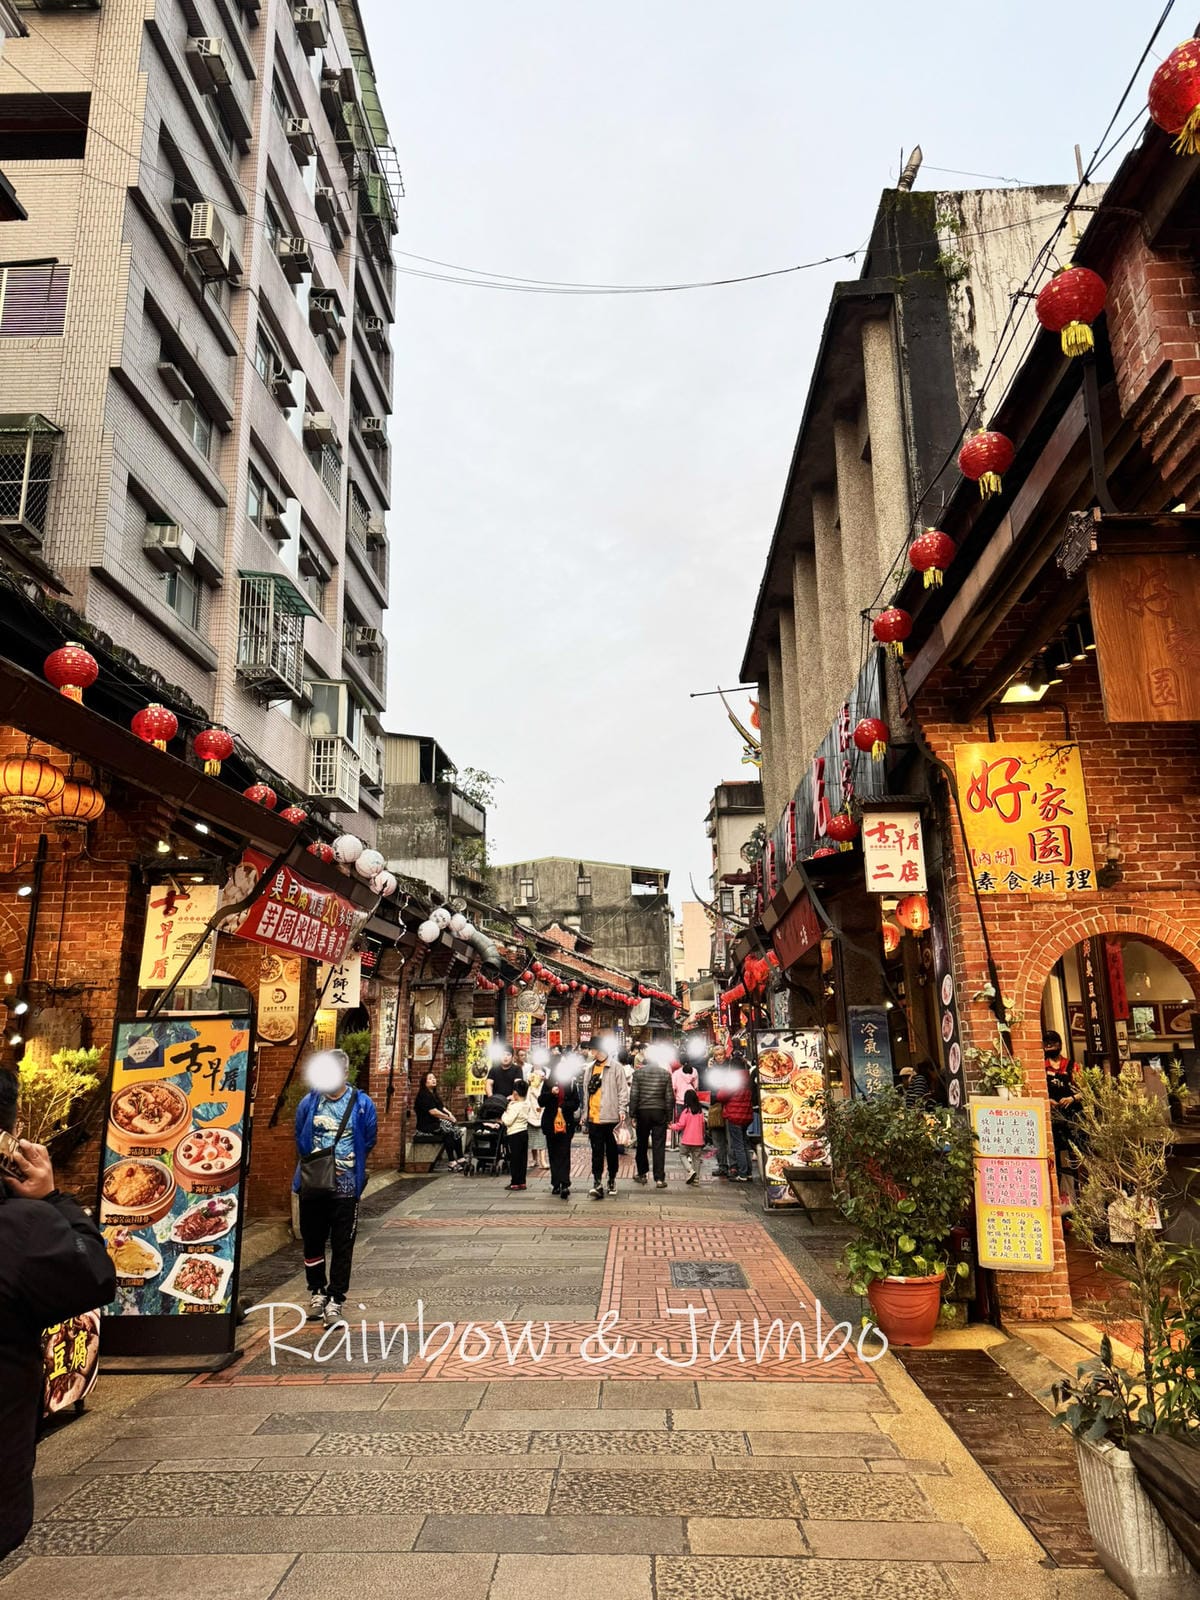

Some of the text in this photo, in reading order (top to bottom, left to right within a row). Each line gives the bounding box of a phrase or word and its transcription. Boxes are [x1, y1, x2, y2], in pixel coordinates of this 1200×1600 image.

[872, 860, 919, 882] 二店
[975, 869, 1092, 890] 素食料理
[331, 964, 350, 1004] 小師父
[860, 1022, 881, 1055] 冷氣
[799, 1058, 825, 1071] 二店
[49, 1330, 88, 1381] 豆腐
